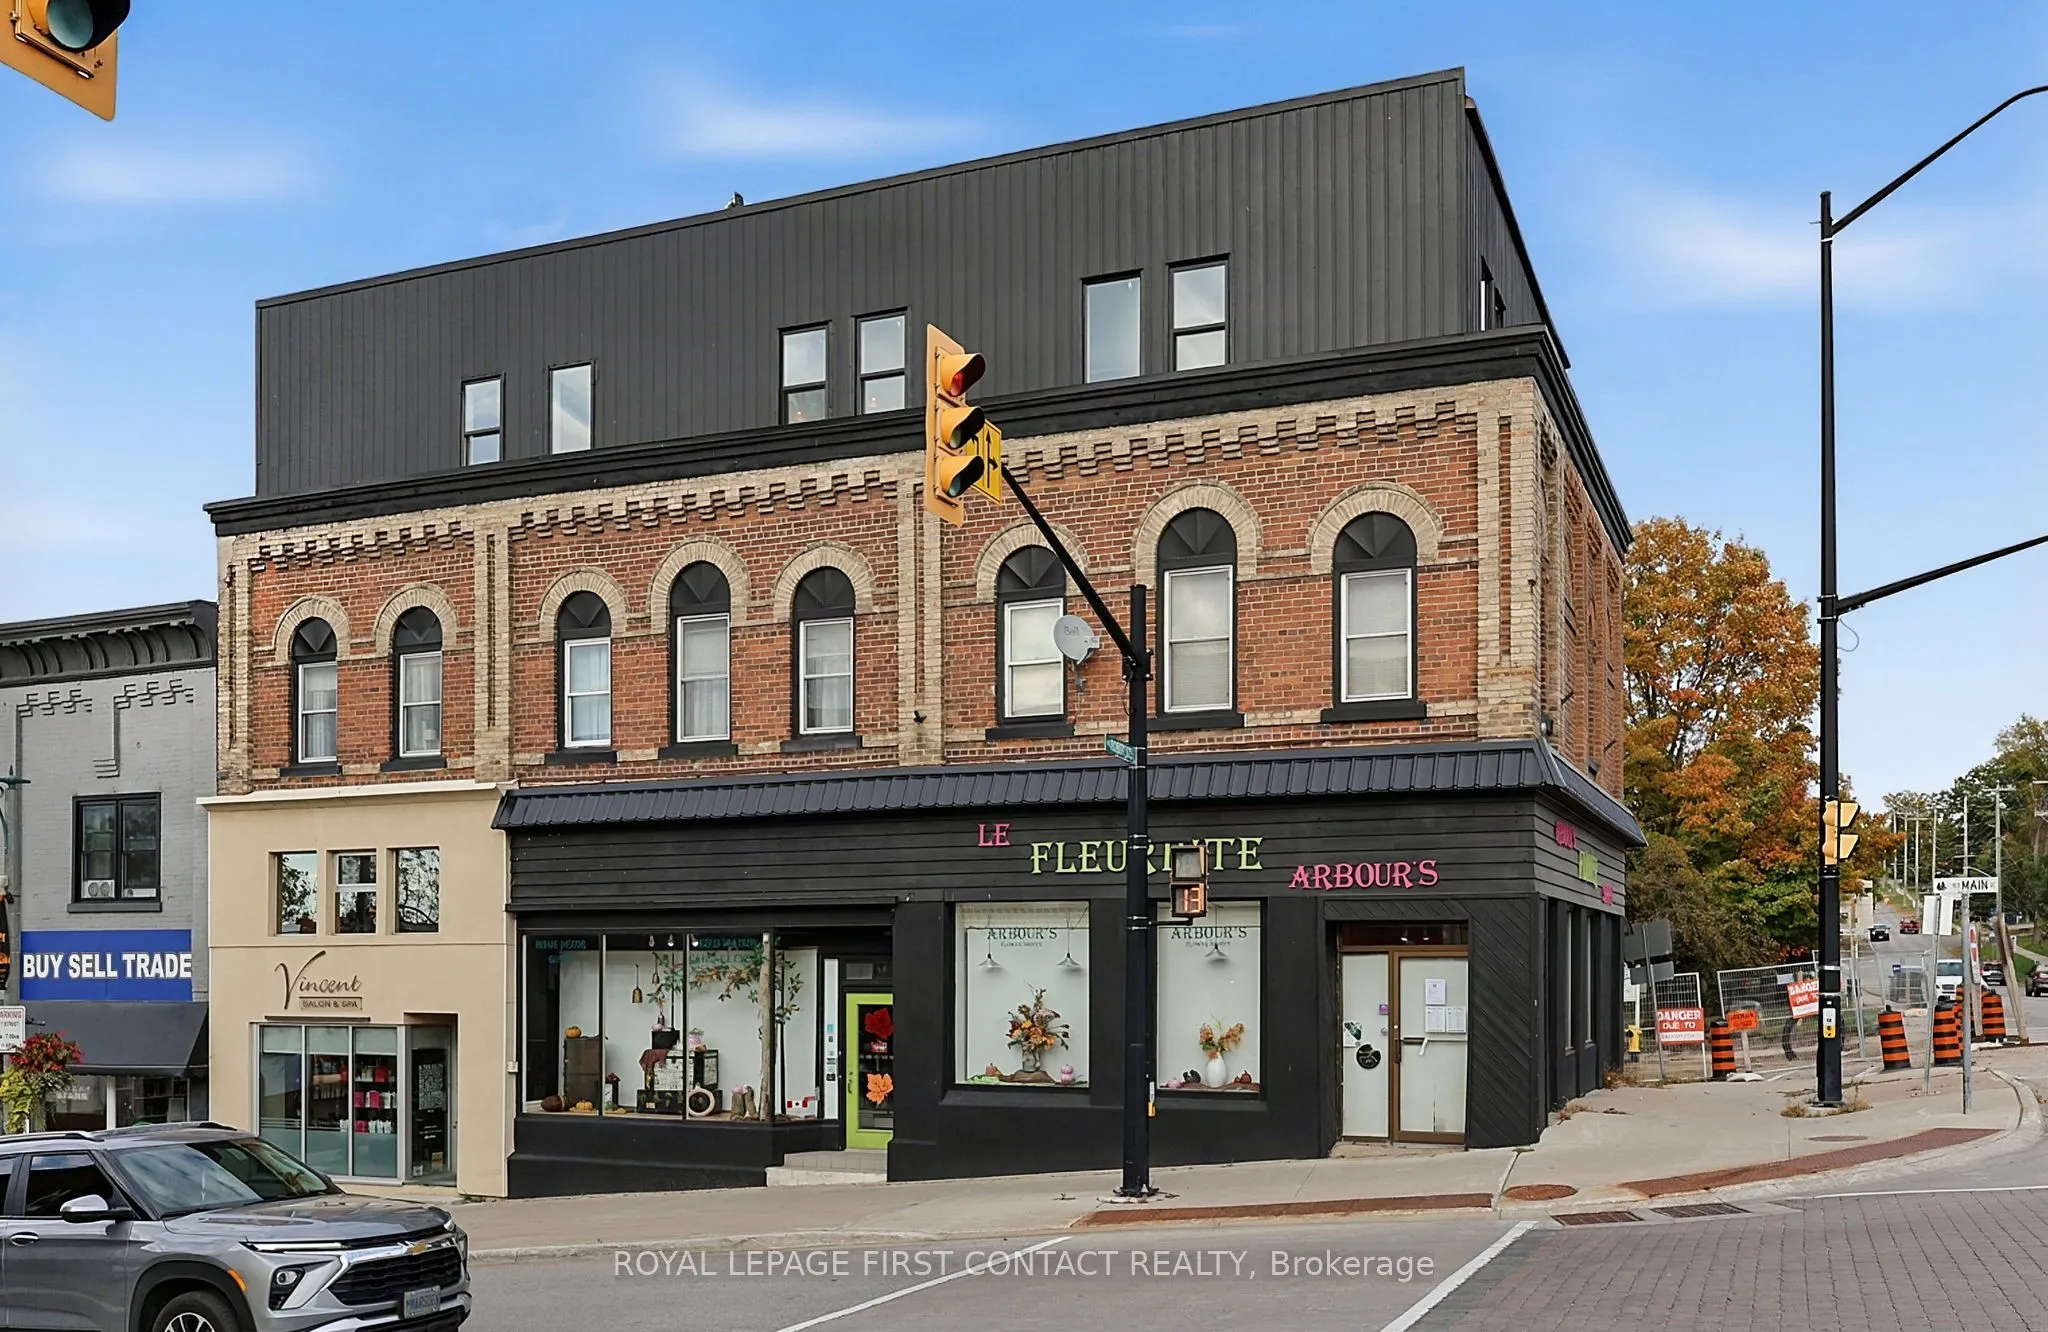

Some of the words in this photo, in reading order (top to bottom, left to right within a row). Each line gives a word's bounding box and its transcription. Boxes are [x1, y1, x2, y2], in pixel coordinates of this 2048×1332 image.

[977, 823, 1011, 847] LE
[1030, 837, 1264, 875] FLEUITE
[1289, 860, 1439, 891] ARBOUR'S
[1962, 880, 1988, 890] MAIN
[987, 927, 1057, 940] ARBOUR'S
[1171, 927, 1247, 940] ARBOUR'S
[23, 953, 64, 979] BUY
[68, 953, 118, 979] SELL
[122, 952, 192, 979] TRADE
[274, 950, 362, 1010] Vincent
[302, 1000, 331, 1008] SALON
[332, 1000, 339, 1008] &
[342, 1000, 358, 1008] SPA
[1657, 1010, 1700, 1021] DANGER
